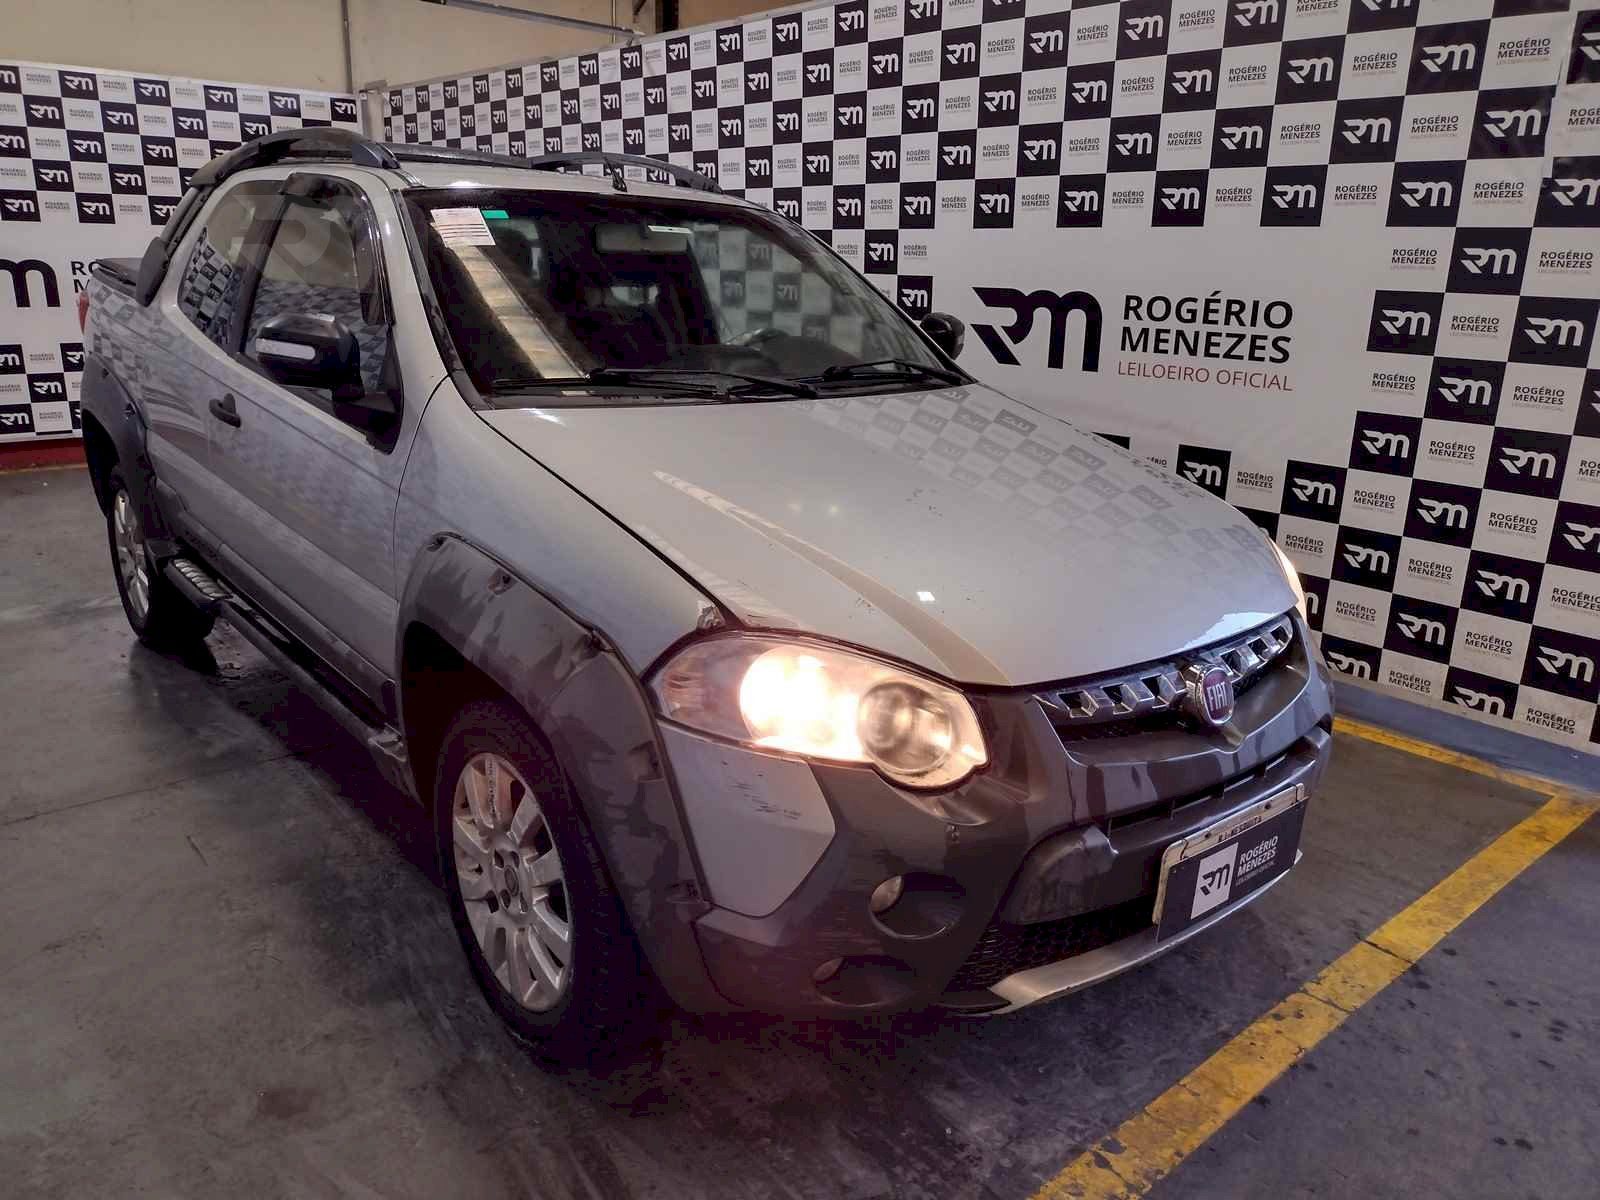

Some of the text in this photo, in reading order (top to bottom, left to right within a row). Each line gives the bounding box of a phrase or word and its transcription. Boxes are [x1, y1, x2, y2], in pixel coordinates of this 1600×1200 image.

[1179, 8, 1215, 20] ROGÉRIO
[1178, 16, 1215, 27] MENEZES
[1076, 23, 1109, 34] ROGÉRIO
[1076, 30, 1108, 42] MENEZES
[1498, 37, 1551, 50] ROGÉRIO
[1353, 51, 1398, 63] ROGÉRIO
[1497, 46, 1550, 58] MENEZES
[1229, 64, 1266, 75] ROGÉRIO
[1352, 60, 1397, 72] MENEZES
[1121, 75, 1154, 86] ROGÉRIO
[1228, 72, 1267, 82] MENEZES
[1120, 83, 1154, 93] MENEZES
[1412, 114, 1459, 125] ROGÉRIO
[1280, 122, 1320, 132] ROGÉRIO
[1410, 123, 1458, 133] MENEZES
[1069, 136, 1100, 145] ROGÉRIO
[1167, 130, 1202, 139] ROGÉRIO
[1280, 131, 1320, 140] MENEZES
[1068, 144, 1099, 152] MENEZES
[1167, 138, 1202, 146] MENEZES
[1216, 186, 1252, 194] ROGÉRIO
[1335, 183, 1377, 192] ROGÉRIO
[1474, 180, 1524, 190] ROGÉRIO
[1112, 189, 1144, 197] ROGÉRIO
[1334, 192, 1376, 200] MENEZES
[1473, 190, 1523, 198] MENEZES
[1392, 247, 1437, 256] ROGÉRIO
[1540, 250, 1593, 260] ROGÉRIO
[1391, 256, 1436, 264] MENEZES
[1538, 259, 1592, 268] MENEZES
[1123, 290, 1293, 329] ROGÉRIO
[1452, 314, 1499, 324] ROGÉRIO
[1450, 323, 1498, 332] MENEZES
[1120, 326, 1292, 363] MENEZES
[1117, 360, 1293, 391] LEILOEIRO OFICIAL
[1372, 372, 1416, 383] ROGÉRIO
[1371, 379, 1415, 390] MENEZES
[1514, 385, 1564, 397] ROGÉRIO
[1512, 393, 1564, 405] MENEZES
[1430, 439, 1475, 452] ROGÉRIO
[1428, 447, 1475, 460] MENEZES
[1237, 470, 1274, 482] ROGÉRIO
[1236, 477, 1272, 488] MENEZES
[1354, 488, 1396, 502] ROGÉRIO
[1353, 496, 1394, 509] MENEZES
[1489, 511, 1538, 526] ROGÉRIO
[1488, 519, 1537, 534] MENEZES
[1286, 533, 1324, 547] ROGÉRIO
[1284, 540, 1323, 553] MENEZES
[1408, 557, 1452, 573] ROGÉRIO
[1407, 565, 1454, 580] MENEZES
[1336, 599, 1376, 615] ROGÉRIO
[1335, 606, 1375, 622] MENEZES
[1466, 630, 1512, 648] ROGÉRIO
[1465, 637, 1512, 655] MENEZES
[1389, 669, 1431, 687] ROGÉRIO
[1388, 676, 1430, 694] MENEZES
[1207, 681, 1227, 711] FIAT
[1527, 706, 1575, 727] ROGÉRIO
[1526, 714, 1575, 735] MENEZES
[1240, 835, 1279, 864] ROGÉRIO
[1238, 846, 1277, 879] MENEZES
